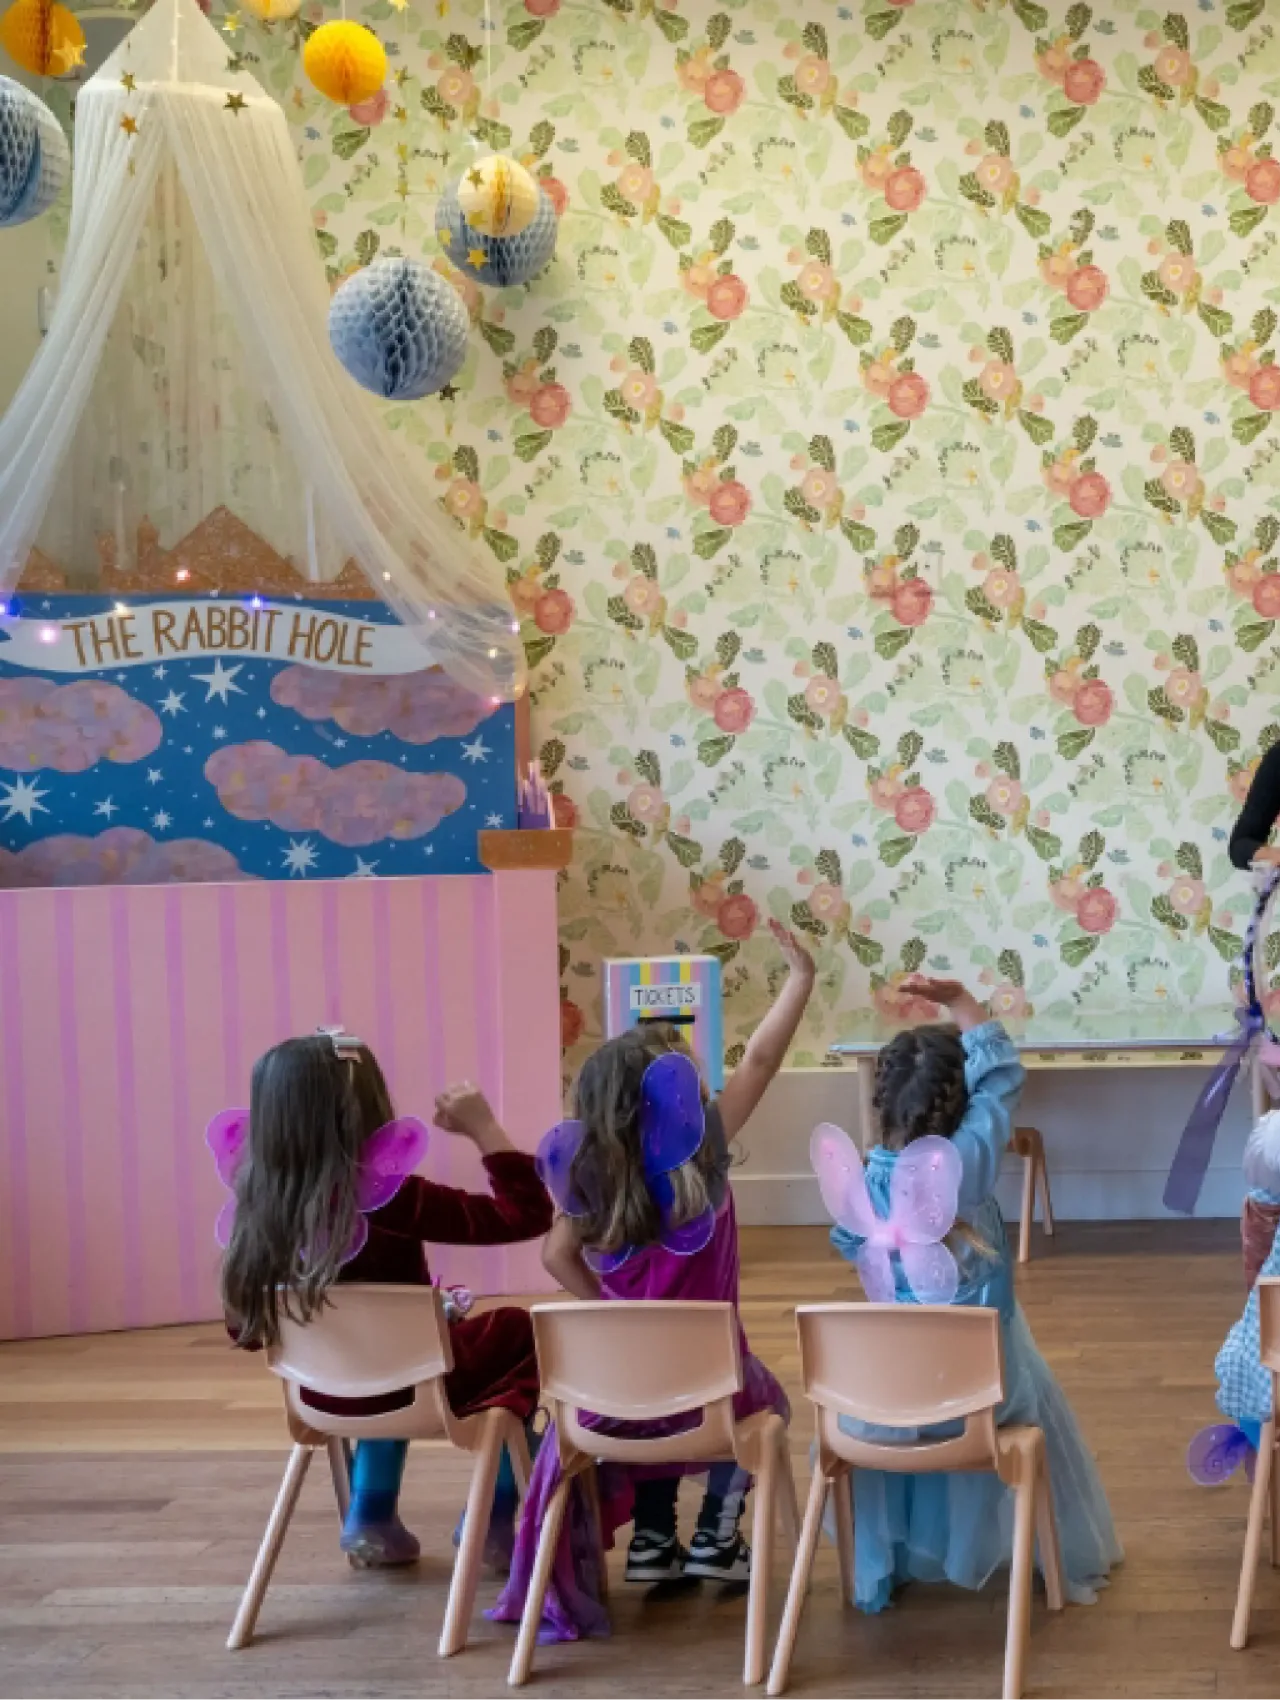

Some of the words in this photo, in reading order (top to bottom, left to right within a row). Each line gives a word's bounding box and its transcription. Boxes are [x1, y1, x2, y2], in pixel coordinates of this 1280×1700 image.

[62, 614, 143, 666] THE
[152, 605, 283, 655] RABBIT
[288, 612, 375, 667] HOLE
[634, 986, 696, 1006] TICKETS
